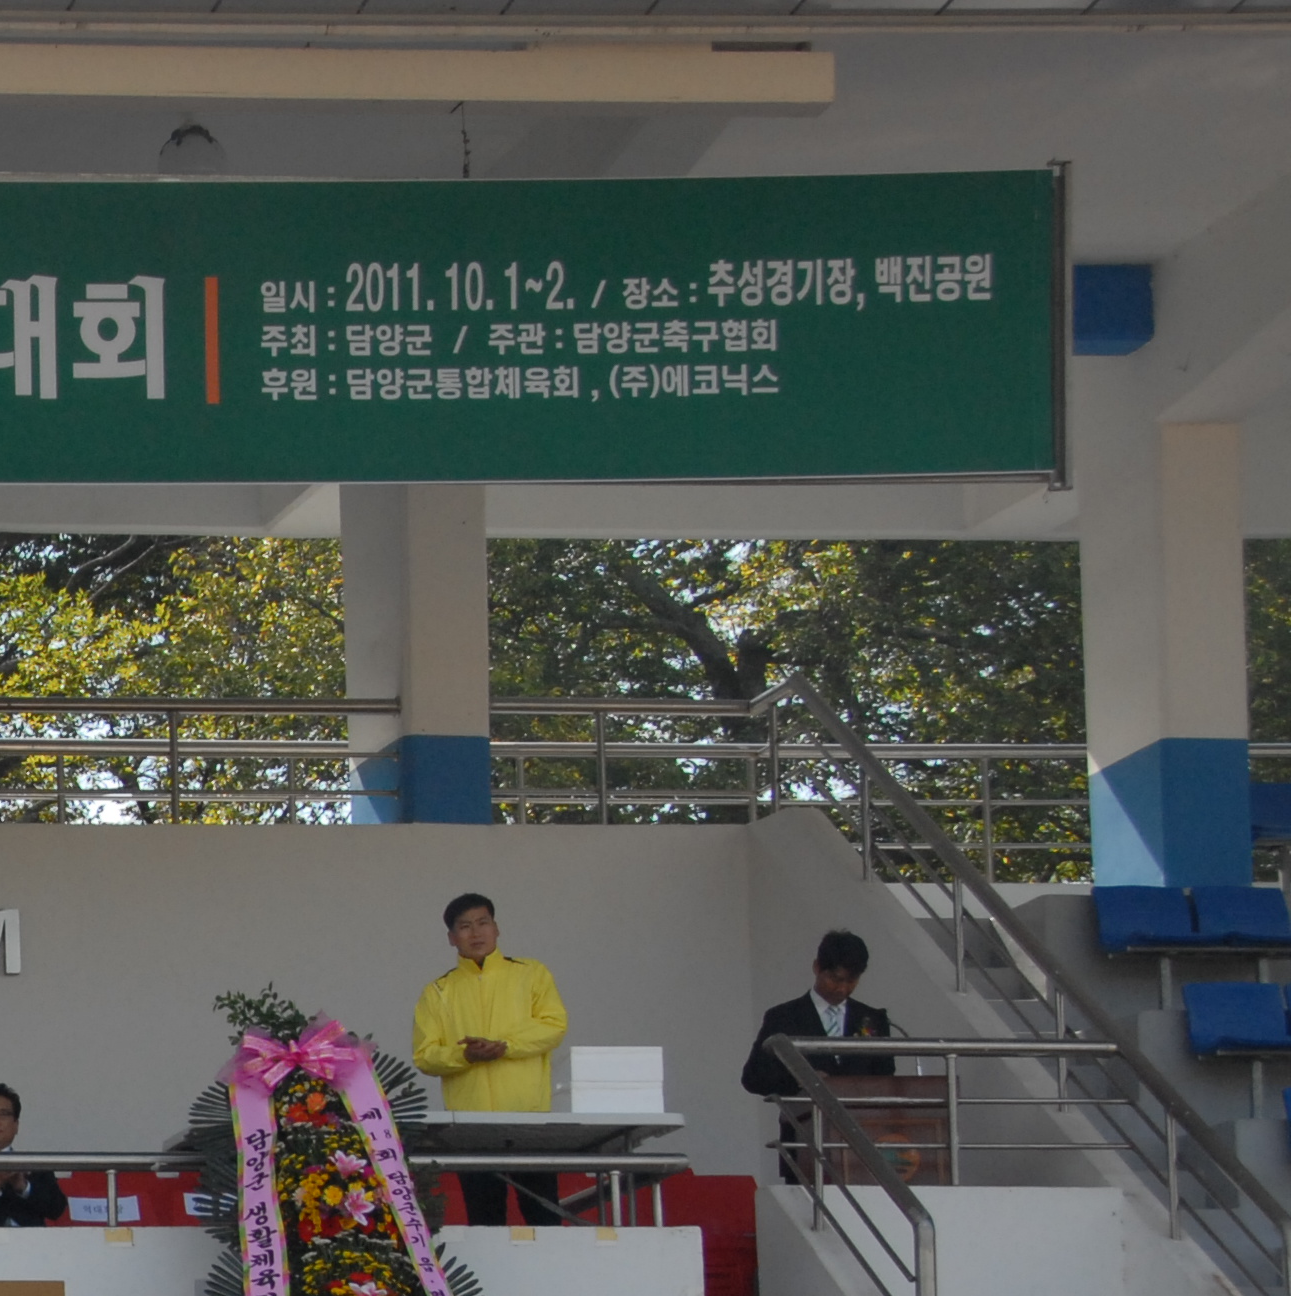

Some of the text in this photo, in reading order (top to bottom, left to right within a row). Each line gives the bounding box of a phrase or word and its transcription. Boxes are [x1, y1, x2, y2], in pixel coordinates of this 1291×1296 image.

[874, 253, 993, 302] 백진공원
[345, 323, 433, 357] 담양군
[573, 319, 779, 355] 담양군축구협회
[609, 363, 780, 399] (주)에코닉스
